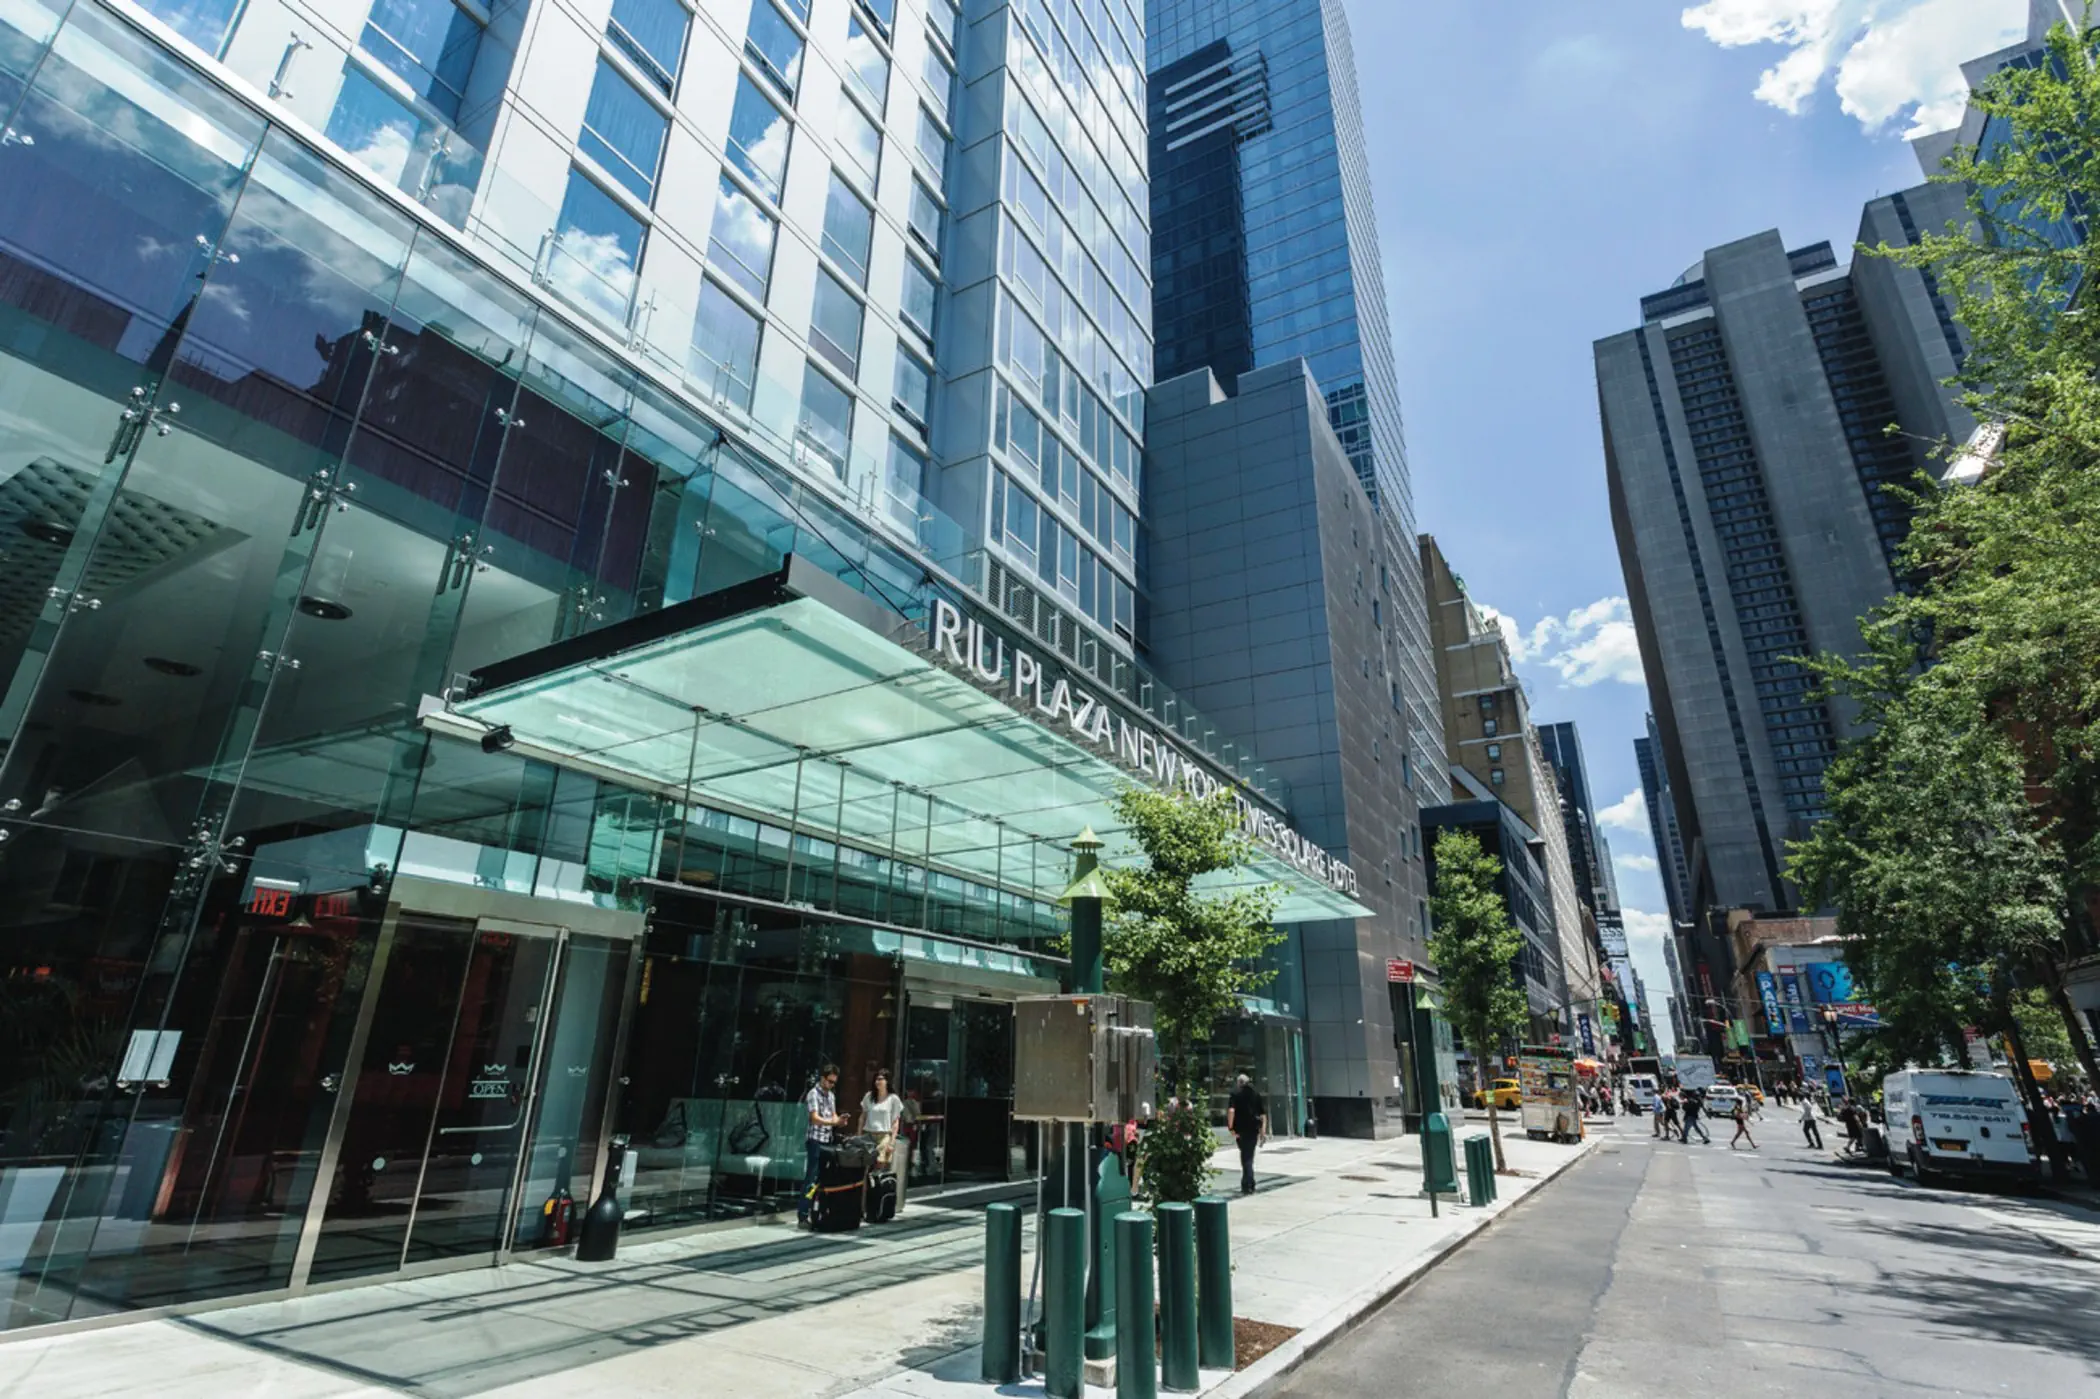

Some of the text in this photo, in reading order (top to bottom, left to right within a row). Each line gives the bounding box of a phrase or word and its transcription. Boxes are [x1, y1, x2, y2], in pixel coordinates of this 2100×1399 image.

[931, 598, 1003, 683] RIU
[1012, 648, 1115, 752] PLAZA
[1120, 716, 1177, 788] NEW
[1231, 789, 1276, 847] TIMES
[1274, 822, 1327, 878] SQUARE
[1327, 853, 1360, 898] HOTEL
[473, 1083, 506, 1096] OPEN
